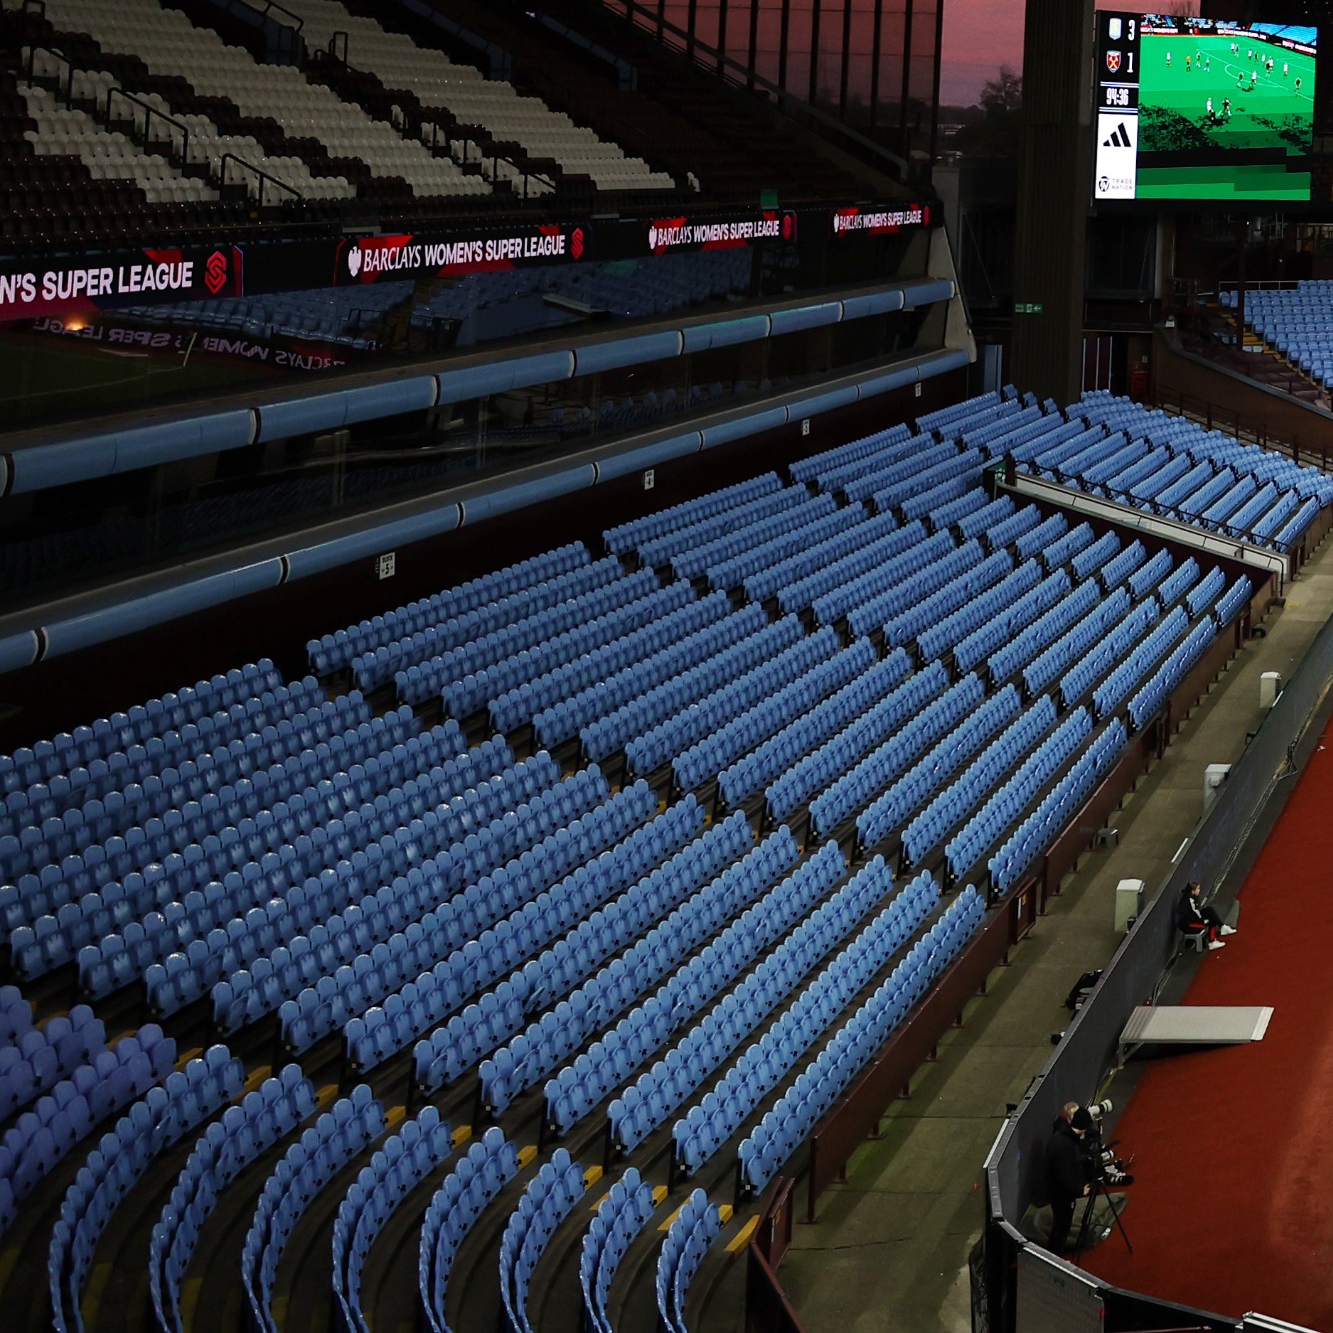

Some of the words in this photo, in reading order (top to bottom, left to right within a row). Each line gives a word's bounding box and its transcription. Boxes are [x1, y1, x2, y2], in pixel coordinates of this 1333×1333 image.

[1127, 19, 1136, 41] 3
[1126, 52, 1134, 73] 1
[1106, 87, 1129, 106] 94:36
[839, 213, 863, 230] BARCLAYS
[863, 212, 887, 228] WOMEN'S
[887, 211, 903, 226] SUPER
[904, 209, 922, 224] LEAGUE
[657, 226, 692, 247] BARCLAYS
[693, 223, 730, 243] WOMEN'S
[730, 221, 753, 239] SUPER
[754, 220, 779, 237] LEAGUE
[363, 244, 421, 273] BARCLAYS
[424, 240, 483, 267] WOMEN'S
[485, 236, 522, 262] SUPER
[524, 234, 565, 258] LEAGUE
[42, 267, 113, 301] SUPER
[117, 261, 194, 294] LEAGUE
